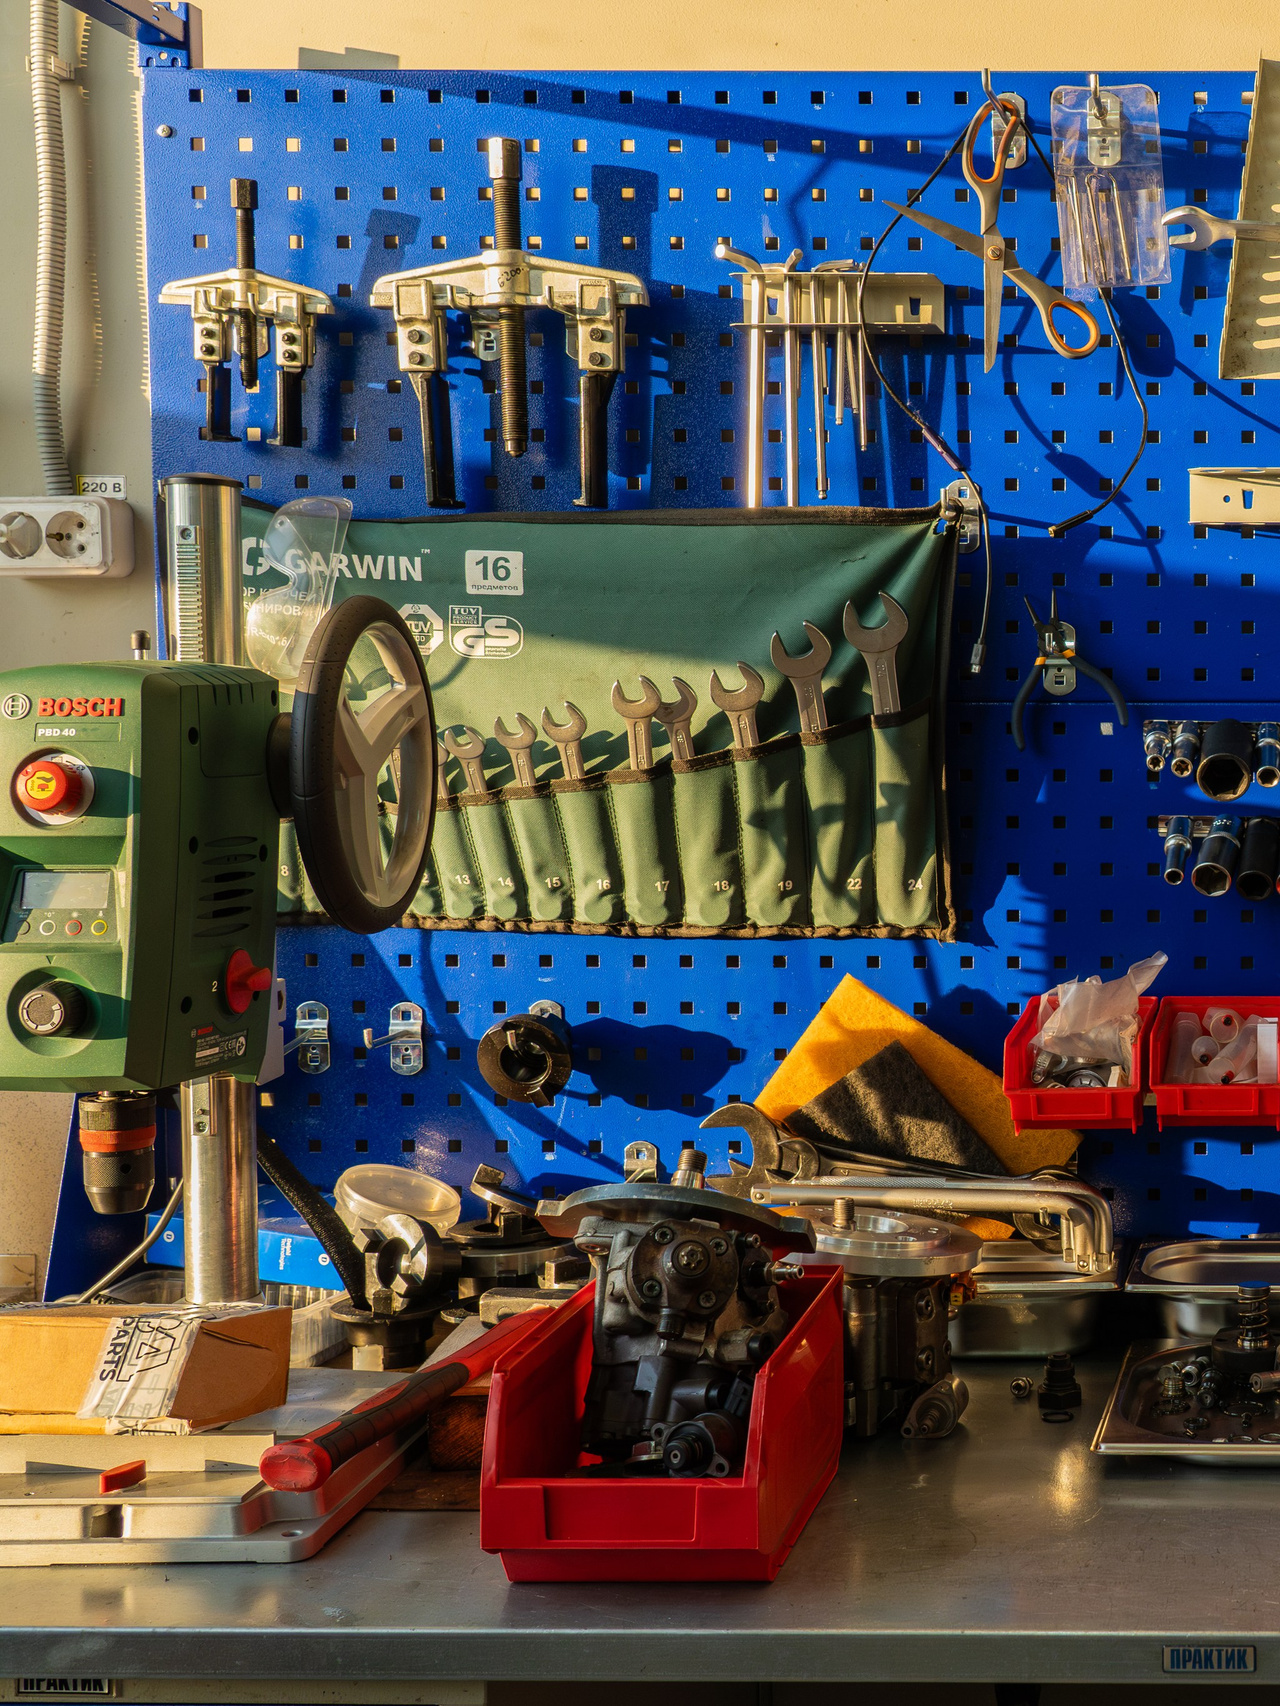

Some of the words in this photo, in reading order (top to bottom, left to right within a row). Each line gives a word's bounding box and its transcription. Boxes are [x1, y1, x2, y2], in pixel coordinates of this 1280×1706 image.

[82, 482, 107, 492] 220
[113, 483, 121, 492] В
[285, 548, 423, 581] GARWIN
[475, 555, 511, 581] 16
[452, 618, 520, 656] GS
[37, 697, 122, 717] BOSCH
[281, 865, 289, 876] 8
[455, 874, 470, 885] 13
[498, 876, 514, 887] 14
[545, 876, 561, 888] 15
[596, 878, 611, 890] 16
[847, 879, 862, 889] 22
[908, 879, 923, 890] 24
[655, 880, 670, 892] 17
[714, 880, 730, 891] 18
[777, 880, 793, 891] 19
[212, 981, 218, 992] 2
[99, 1316, 136, 1382] PARTS
[1170, 1648, 1248, 1670] ПРАКТИК
